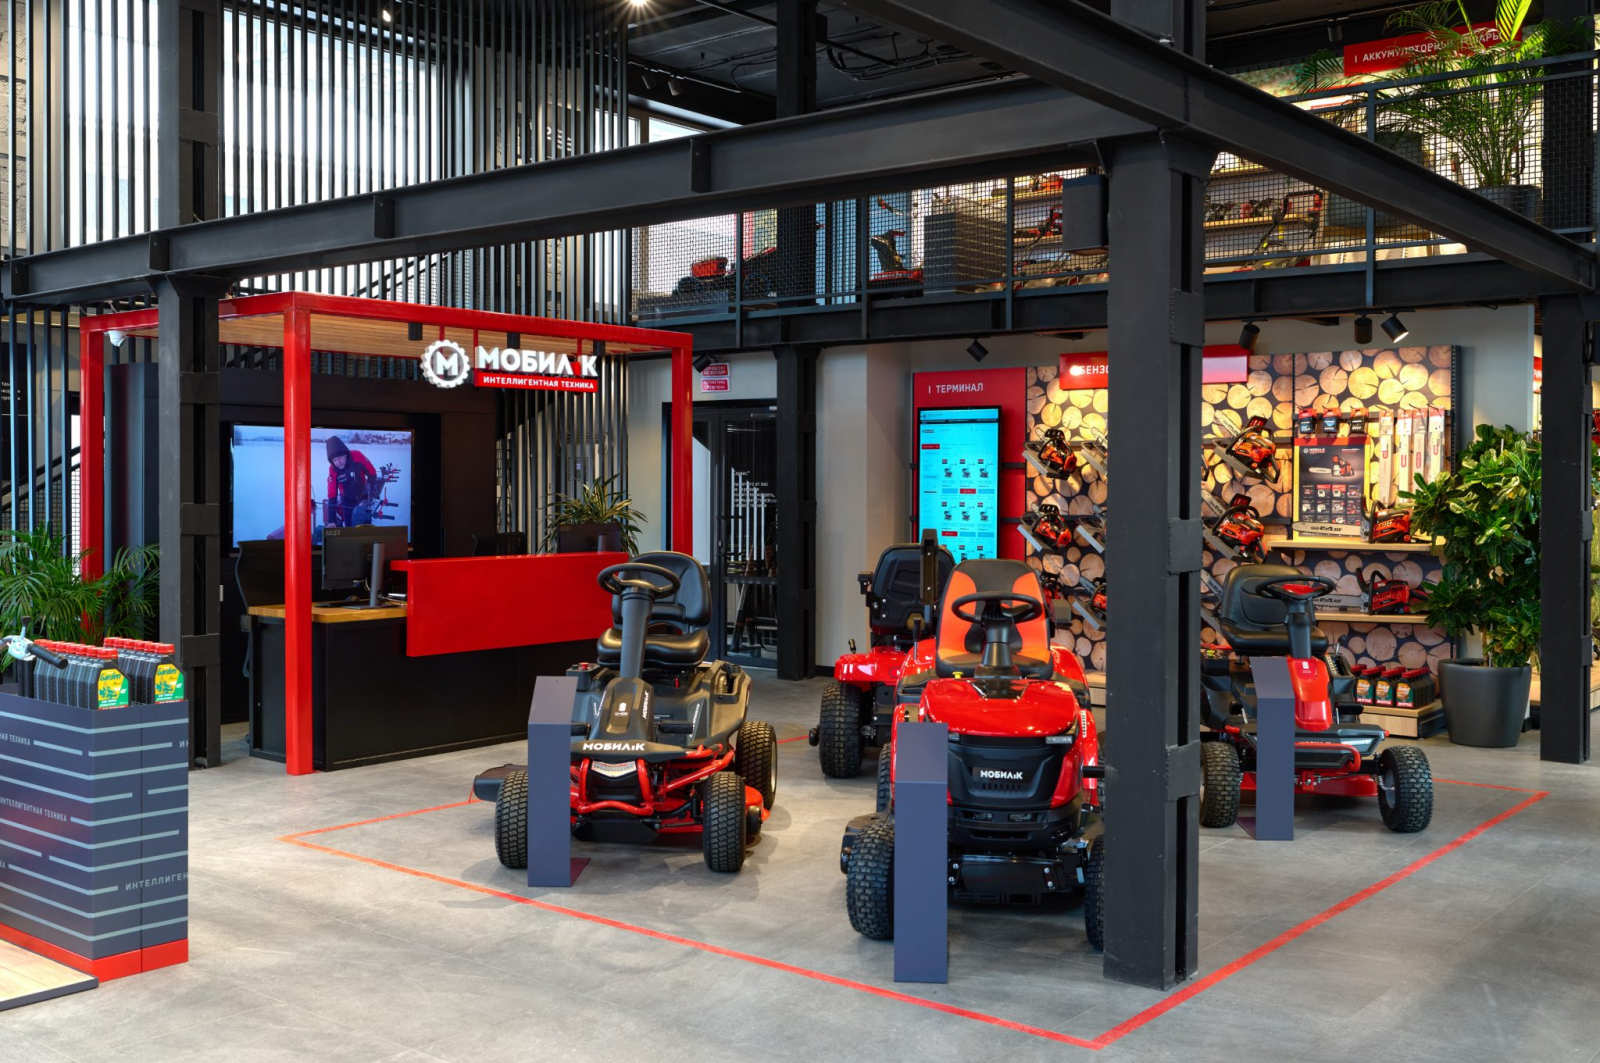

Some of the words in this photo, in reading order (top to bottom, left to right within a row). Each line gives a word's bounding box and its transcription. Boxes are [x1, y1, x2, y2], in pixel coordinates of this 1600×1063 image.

[483, 376, 559, 387] ИНТЕЛЛИГЕНТНАЯ
[561, 380, 594, 389] ТЕХНИКА
[936, 382, 984, 394] ТЕРМИНАЛ
[99, 671, 122, 681] Garden
[157, 666, 177, 676] Garden
[9, 734, 31, 746] ТЕХНИКА
[44, 809, 67, 822] ТЕХНИКА
